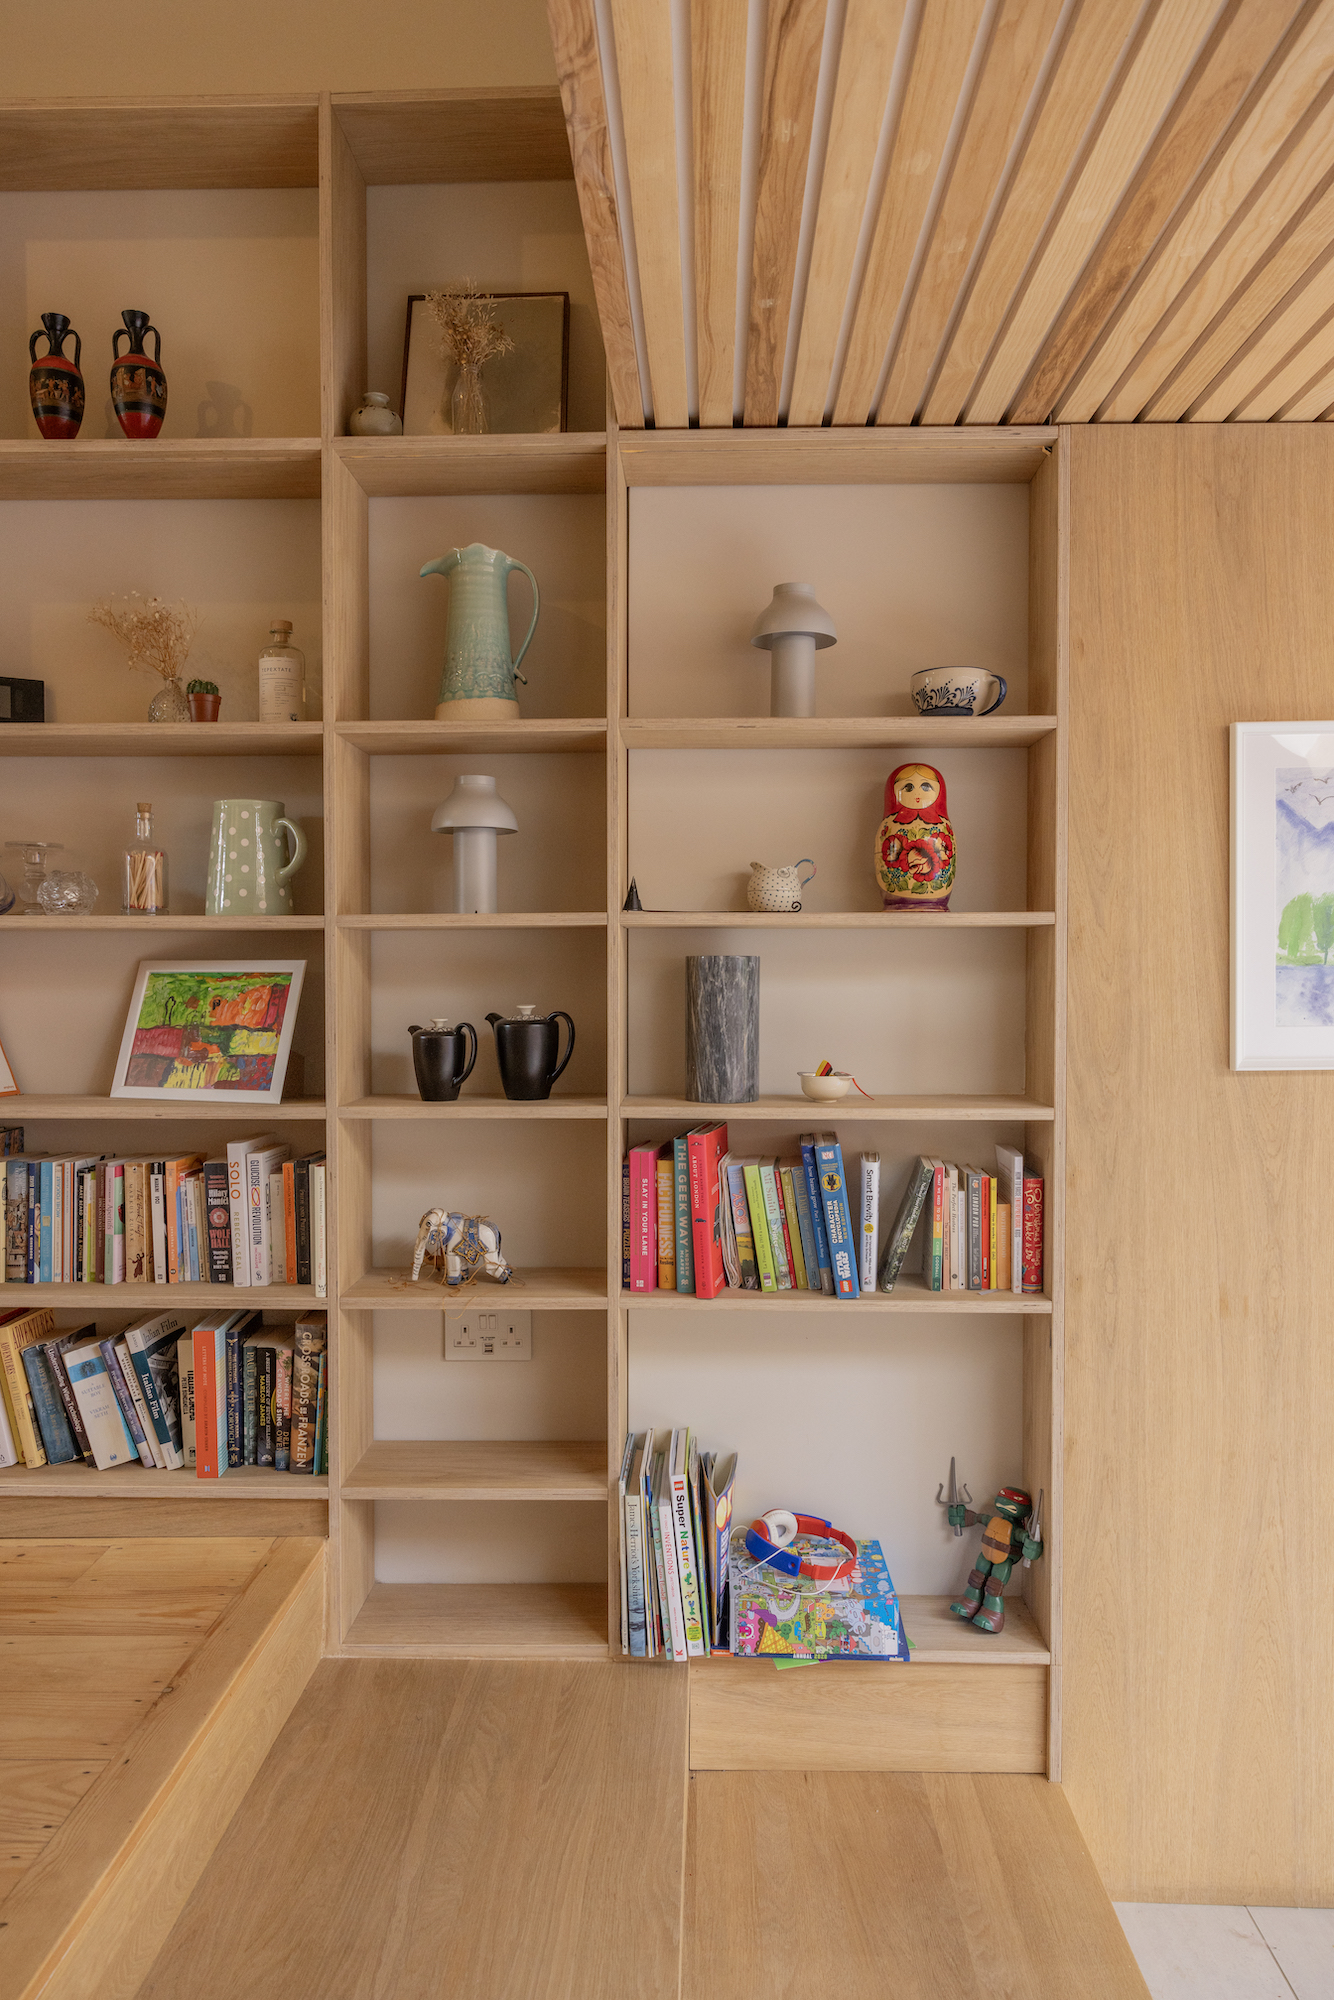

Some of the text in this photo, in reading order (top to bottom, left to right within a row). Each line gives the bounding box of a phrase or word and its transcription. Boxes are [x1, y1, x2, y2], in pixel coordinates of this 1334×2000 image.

[208, 1189, 228, 1198] Hilary
[230, 1162, 241, 1199] SOLO
[677, 1143, 688, 1246] THE GEEK WAY
[794, 1168, 804, 1193] ROALD
[1025, 1188, 1042, 1204] 50
[208, 1196, 229, 1206] Mantel
[250, 1160, 262, 1246] GLUCOSE REVOLUTION
[642, 1201, 648, 1209] IN
[658, 1172, 673, 1257] FACTFULNESS
[766, 1188, 774, 1214] Smith
[798, 1194, 808, 1215] DAHL
[864, 1196, 873, 1223] Brevity
[134, 1216, 144, 1238] Thief
[209, 1229, 230, 1238] WOLF
[827, 1201, 838, 1244] CHARACTER
[833, 1200, 844, 1244] ENCYCLOPEDIA
[1034, 1204, 1043, 1266] Christmas Things
[211, 1238, 230, 1248] HALL
[1026, 1248, 1033, 1260] Do
[836, 1251, 846, 1277] STAR
[840, 1250, 852, 1280] WARS
[12, 1308, 54, 1350] ADVENTURES
[160, 1318, 178, 1333] Film
[36, 1356, 52, 1408] LABYRINTH
[48, 1348, 82, 1433] Understanding Wine Technology
[111, 1371, 130, 1410] reading between
[142, 1373, 160, 1420] Italian Film
[246, 1352, 255, 1412] PAUL AUSTER
[296, 1332, 312, 1468] CROSSROADS FRANZEN
[675, 1494, 689, 1569] Super Nature
[628, 1502, 640, 1606] James Herriot's Yorkshire
[664, 1532, 674, 1575] INVENTIONS
